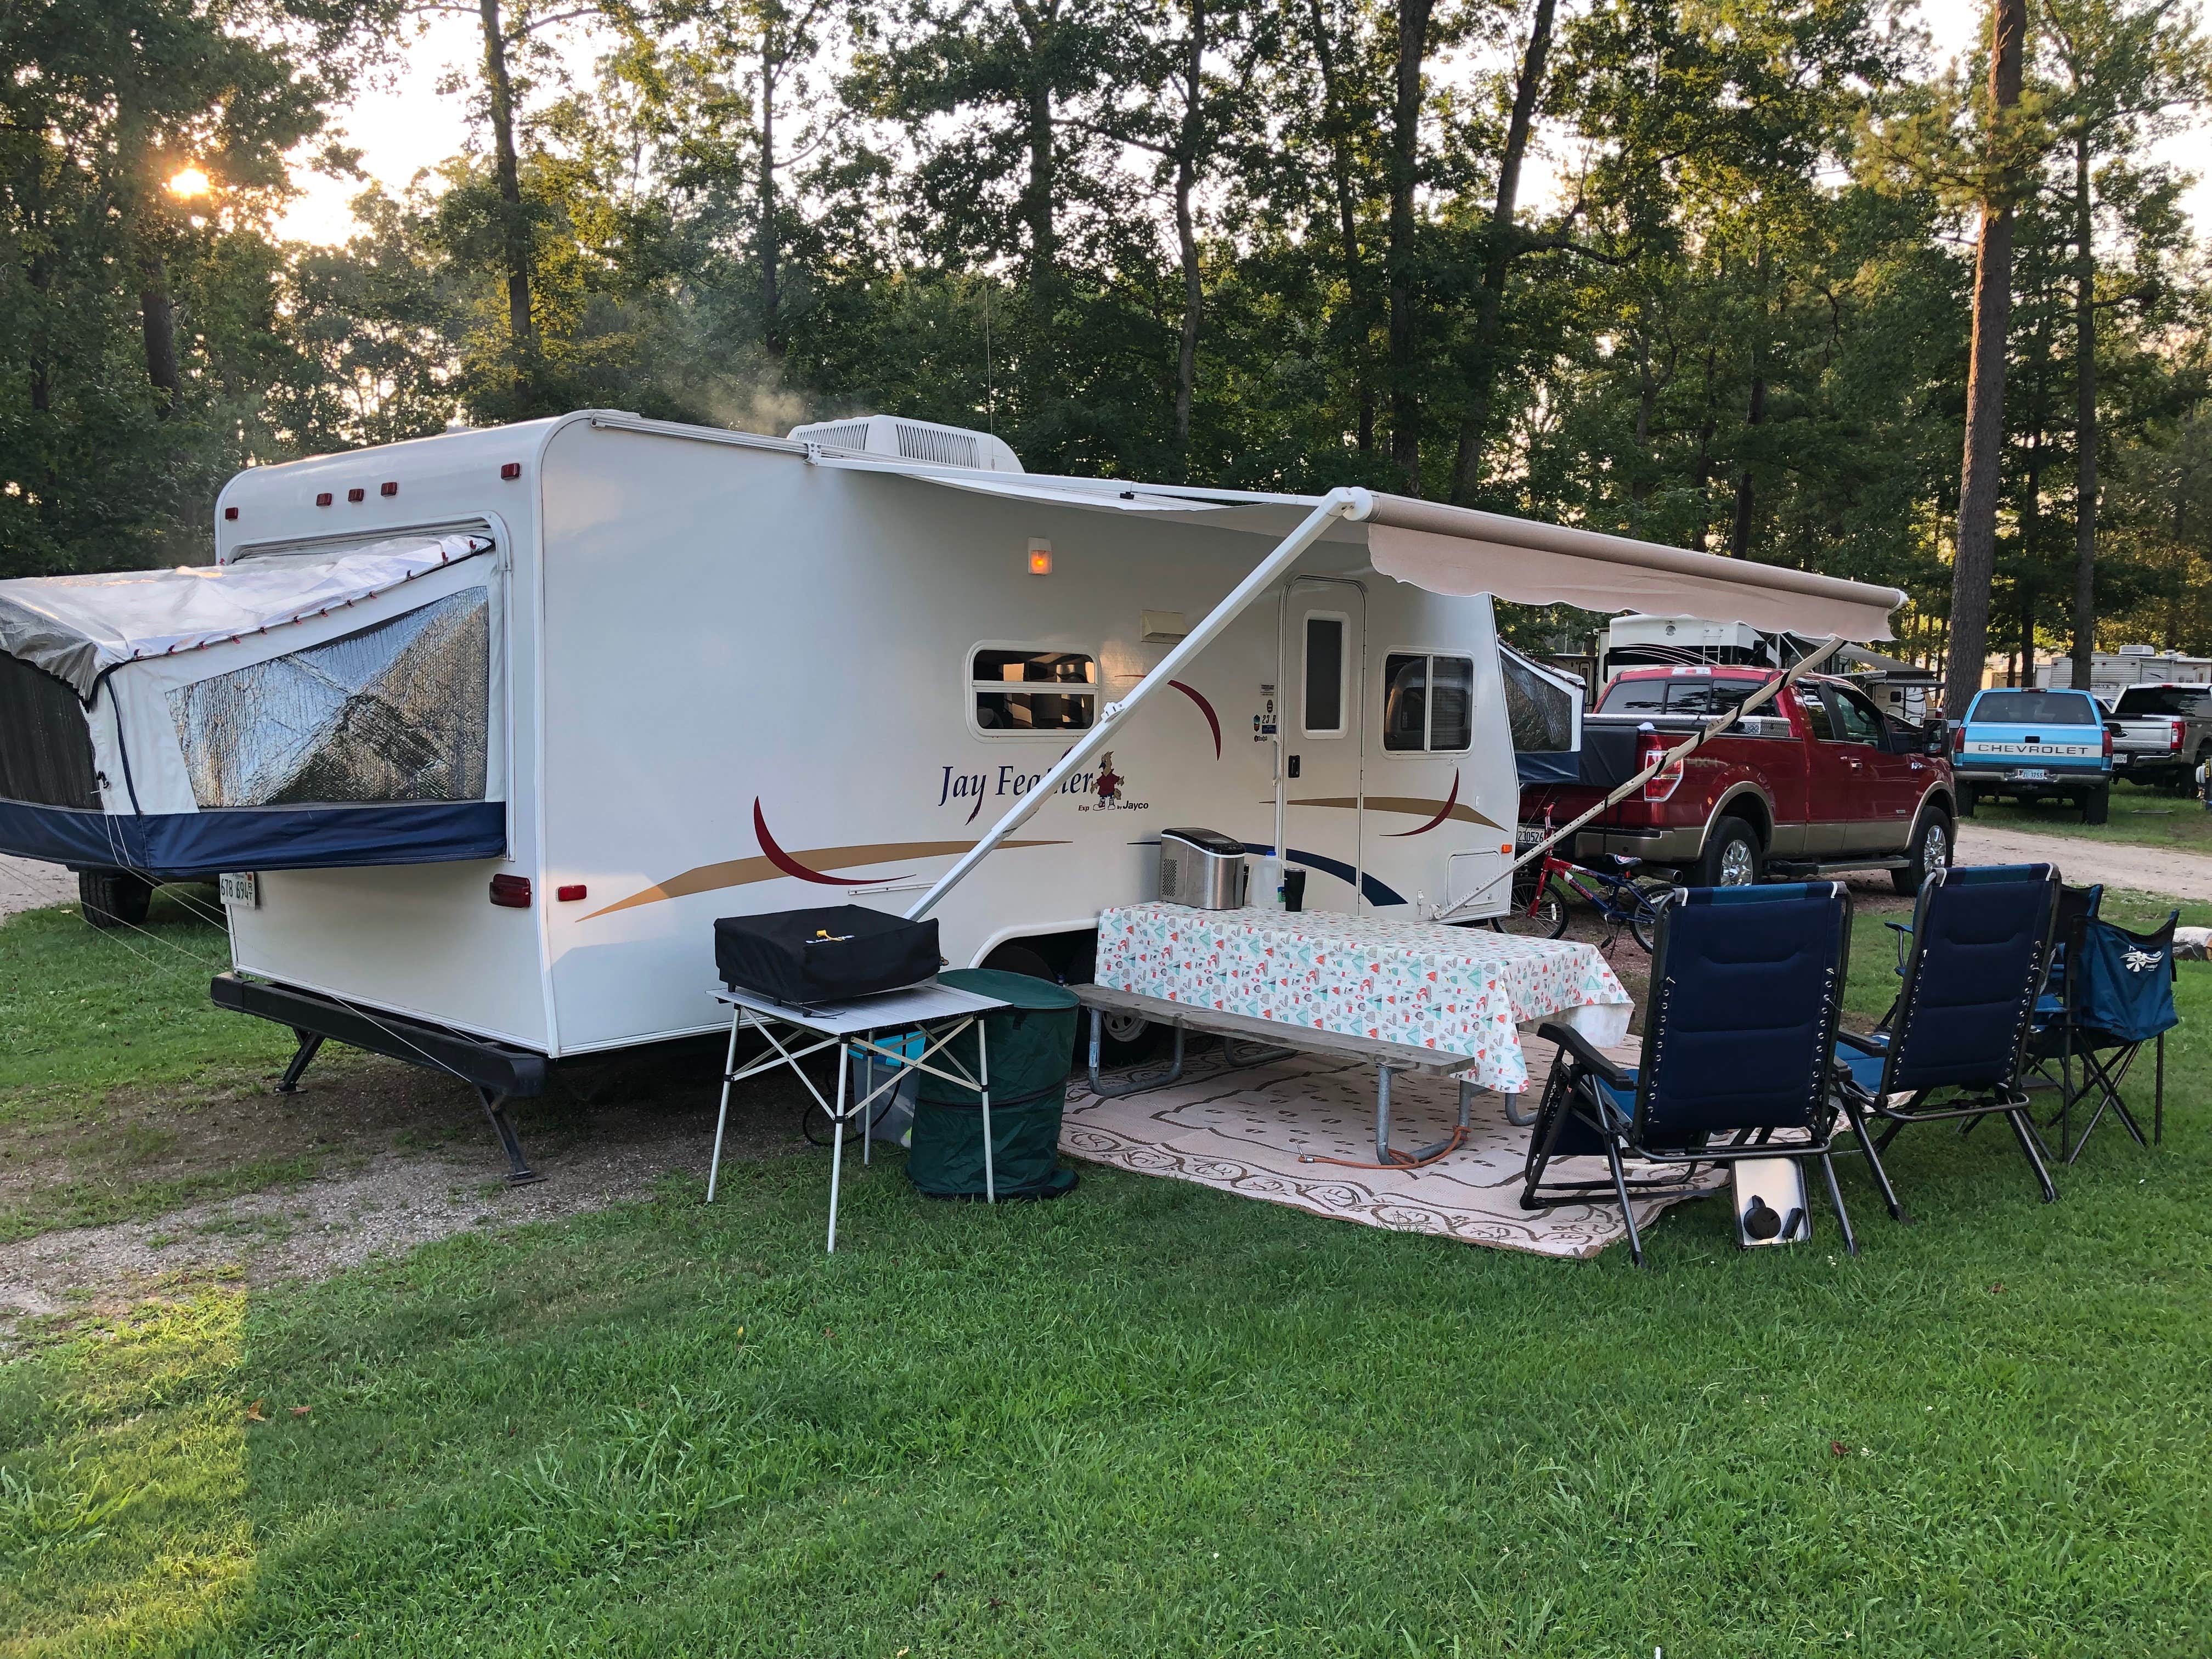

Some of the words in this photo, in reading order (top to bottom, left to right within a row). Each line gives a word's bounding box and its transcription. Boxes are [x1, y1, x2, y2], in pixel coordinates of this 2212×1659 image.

[1262, 714, 1270, 724] 23
[1978, 744, 2089, 754] CHEVROLET
[938, 765, 987, 826] Jay
[995, 746, 1094, 796] Feaer
[1122, 800, 1149, 811] Jayco
[221, 878, 233, 898] 678
[236, 881, 249, 900] 694
